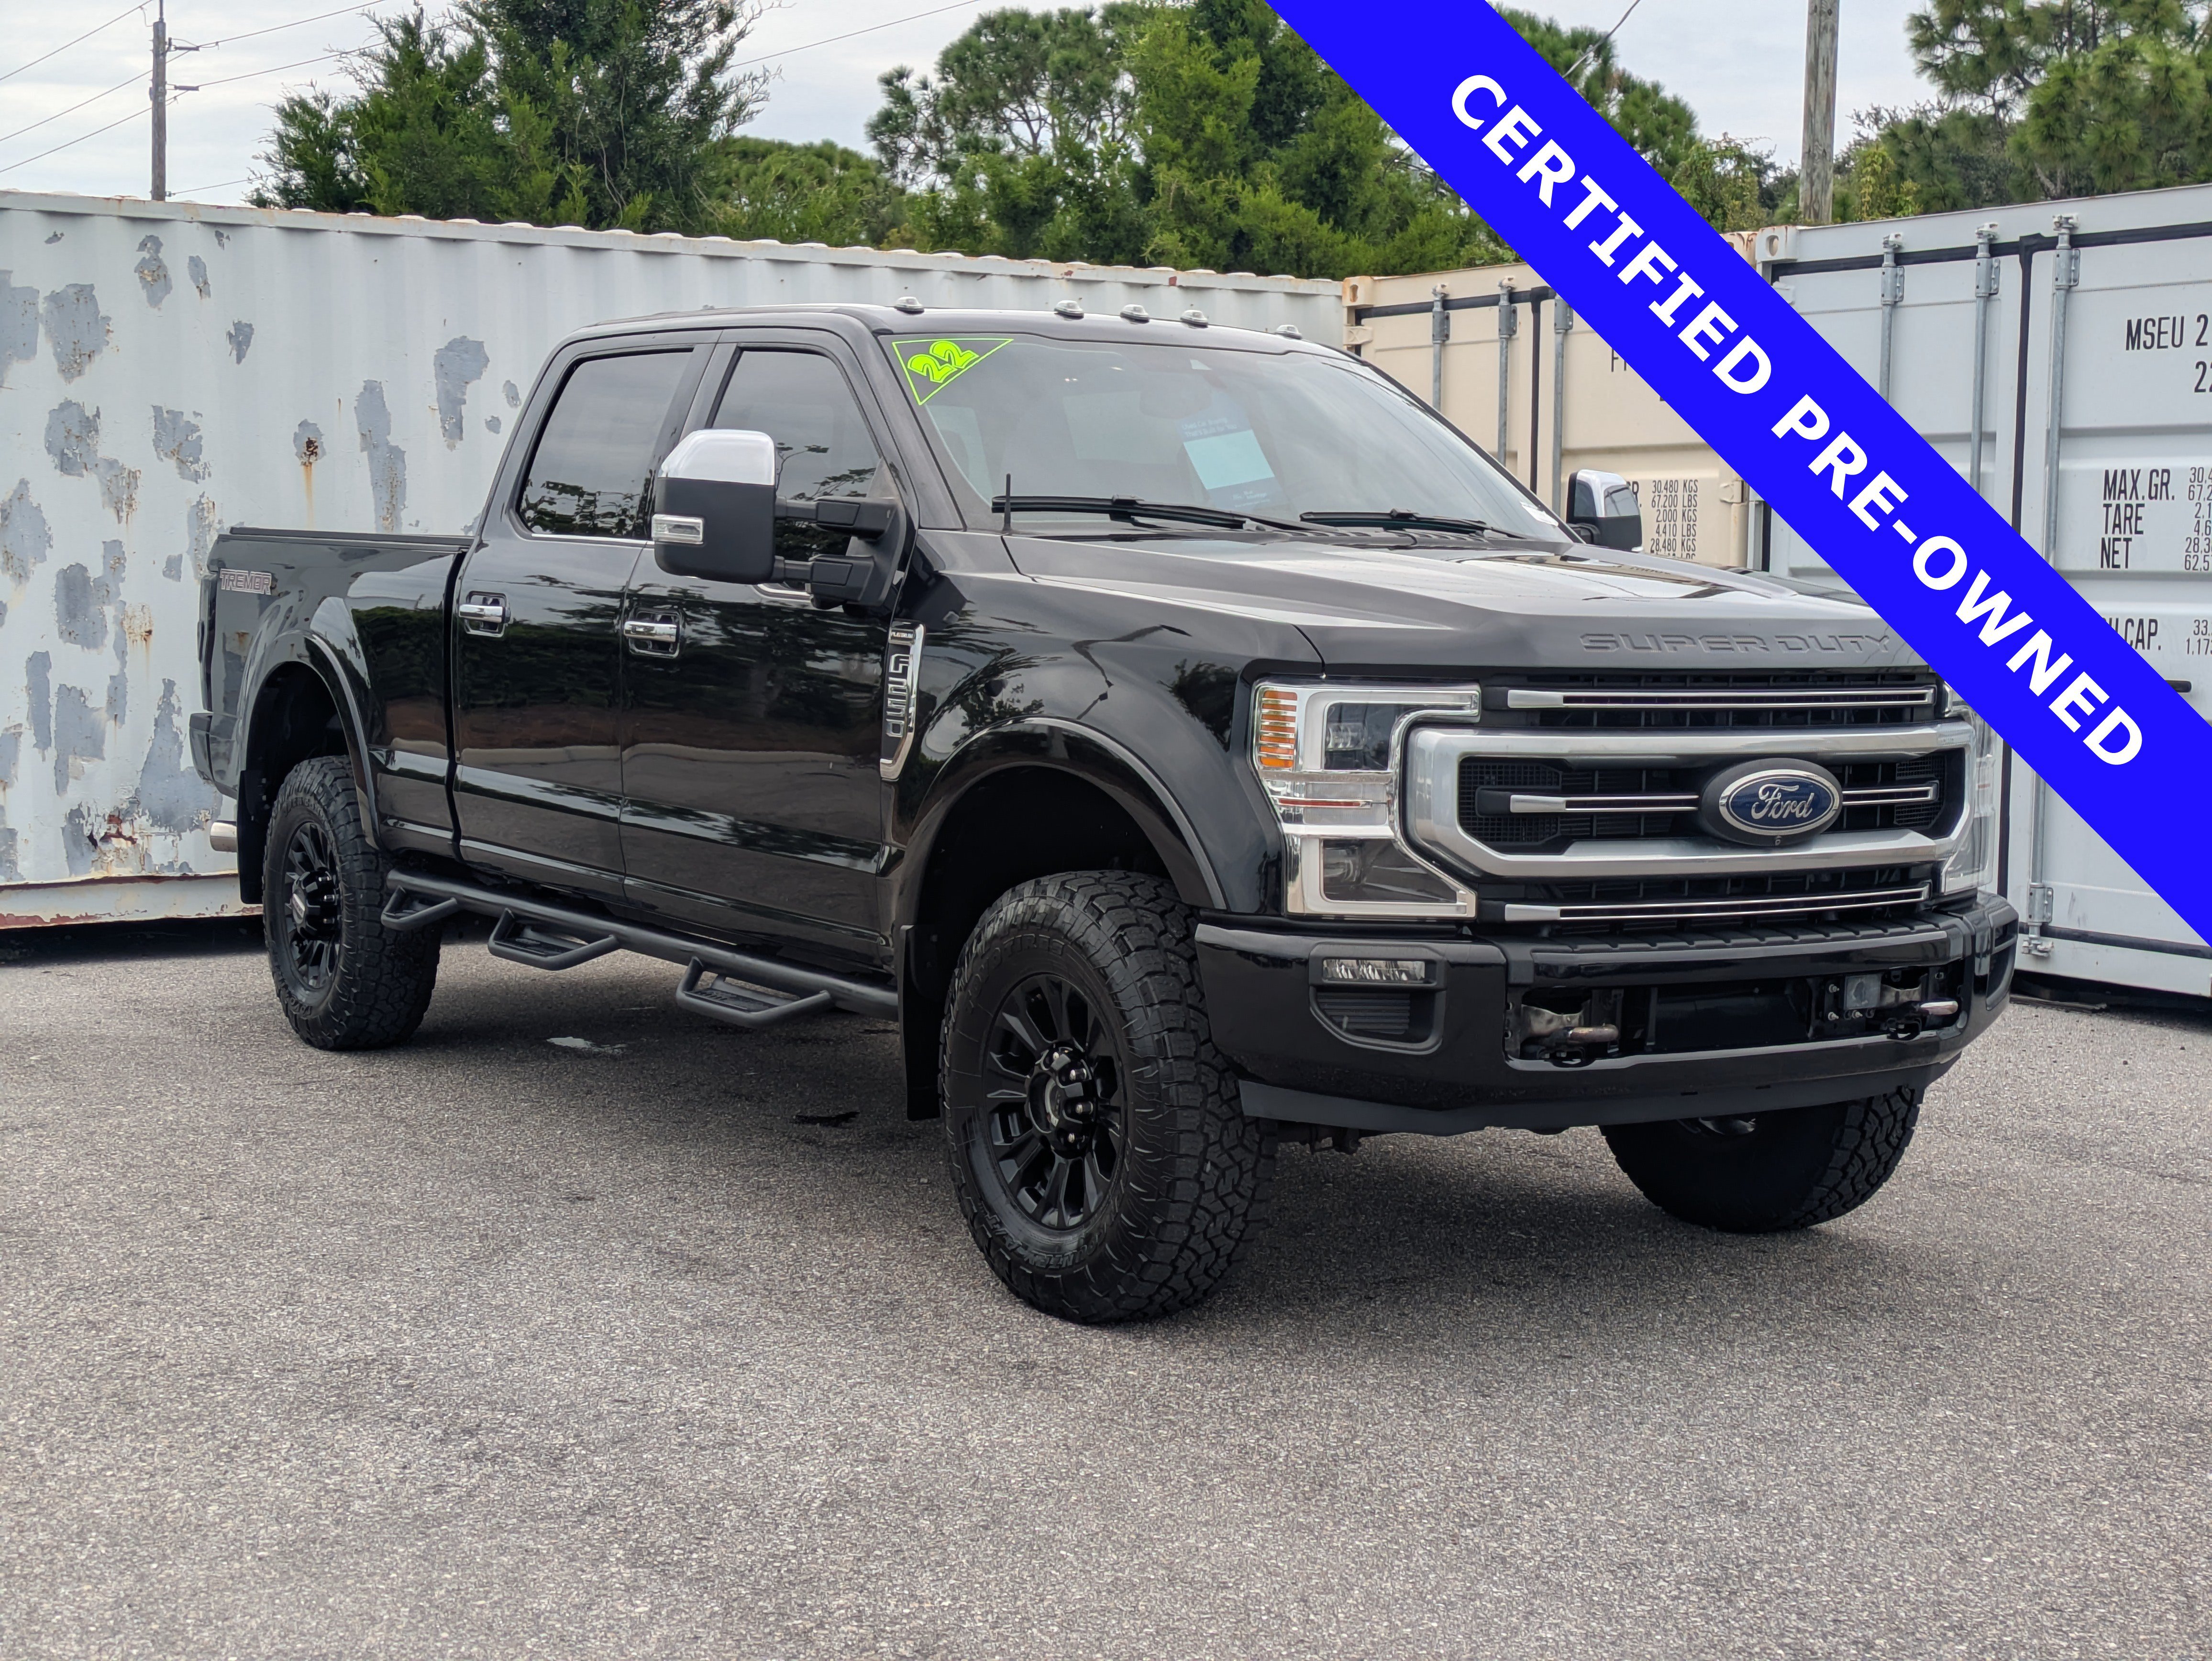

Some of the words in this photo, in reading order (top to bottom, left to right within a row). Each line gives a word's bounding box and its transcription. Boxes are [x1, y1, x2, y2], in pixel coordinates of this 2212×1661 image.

[2125, 316, 2184, 351] MSEU
[907, 340, 979, 383] 22
[1683, 479, 1698, 493] KGS
[1682, 494, 1698, 508] LBS
[1681, 509, 1697, 522] KGS
[2103, 503, 2145, 535] TARE
[1681, 523, 1696, 537] LBS
[1681, 538, 1696, 552] KGS
[2101, 537, 2132, 568] NET
[220, 568, 272, 596] TREMOR
[1580, 633, 1770, 653] SUPER
[1775, 635, 1890, 653] DUTY
[1751, 784, 1814, 819] Ford
